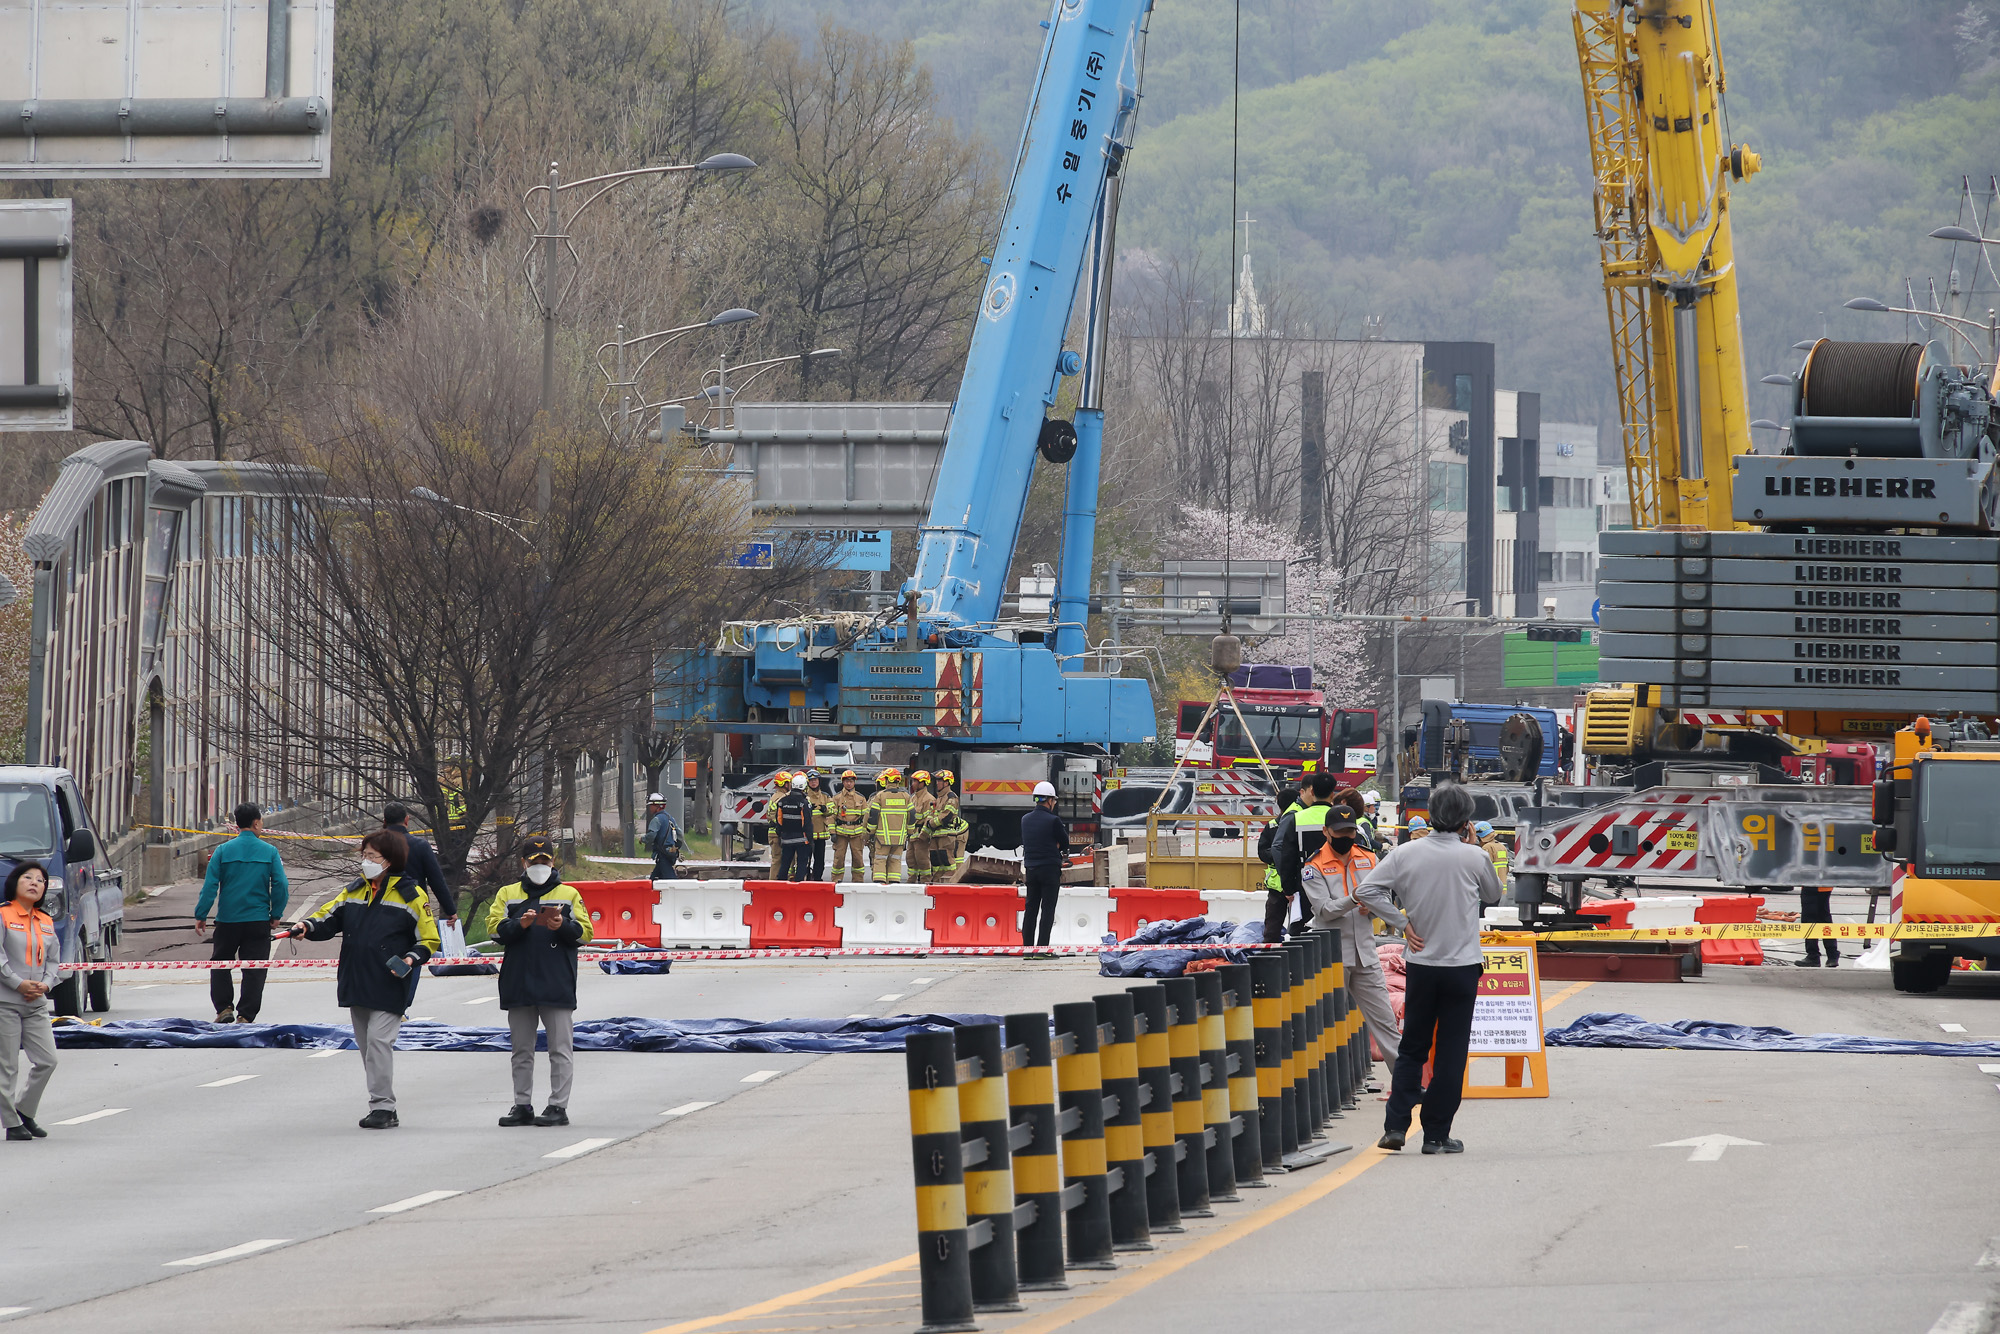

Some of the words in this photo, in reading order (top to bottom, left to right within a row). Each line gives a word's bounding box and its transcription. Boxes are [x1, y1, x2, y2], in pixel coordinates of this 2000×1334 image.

[1765, 476, 1936, 498] LIEBHERR
[1794, 538, 1902, 556] LIEBHERR
[1794, 565, 1902, 583] LIEBHERR
[1794, 590, 1902, 608] LIEBHERR
[1794, 616, 1902, 635] LIEBHERR
[1794, 642, 1902, 660] LIEBHERR
[870, 666, 922, 674] LIEBHERR
[1794, 667, 1902, 685] LIEBHERR
[870, 694, 922, 702] LIEBHERR
[870, 712, 921, 720] LIEBHERR
[1254, 705, 1287, 713] 경기도소방
[1298, 742, 1316, 751] 구조
[1925, 867, 1986, 876] LIEBHERR
